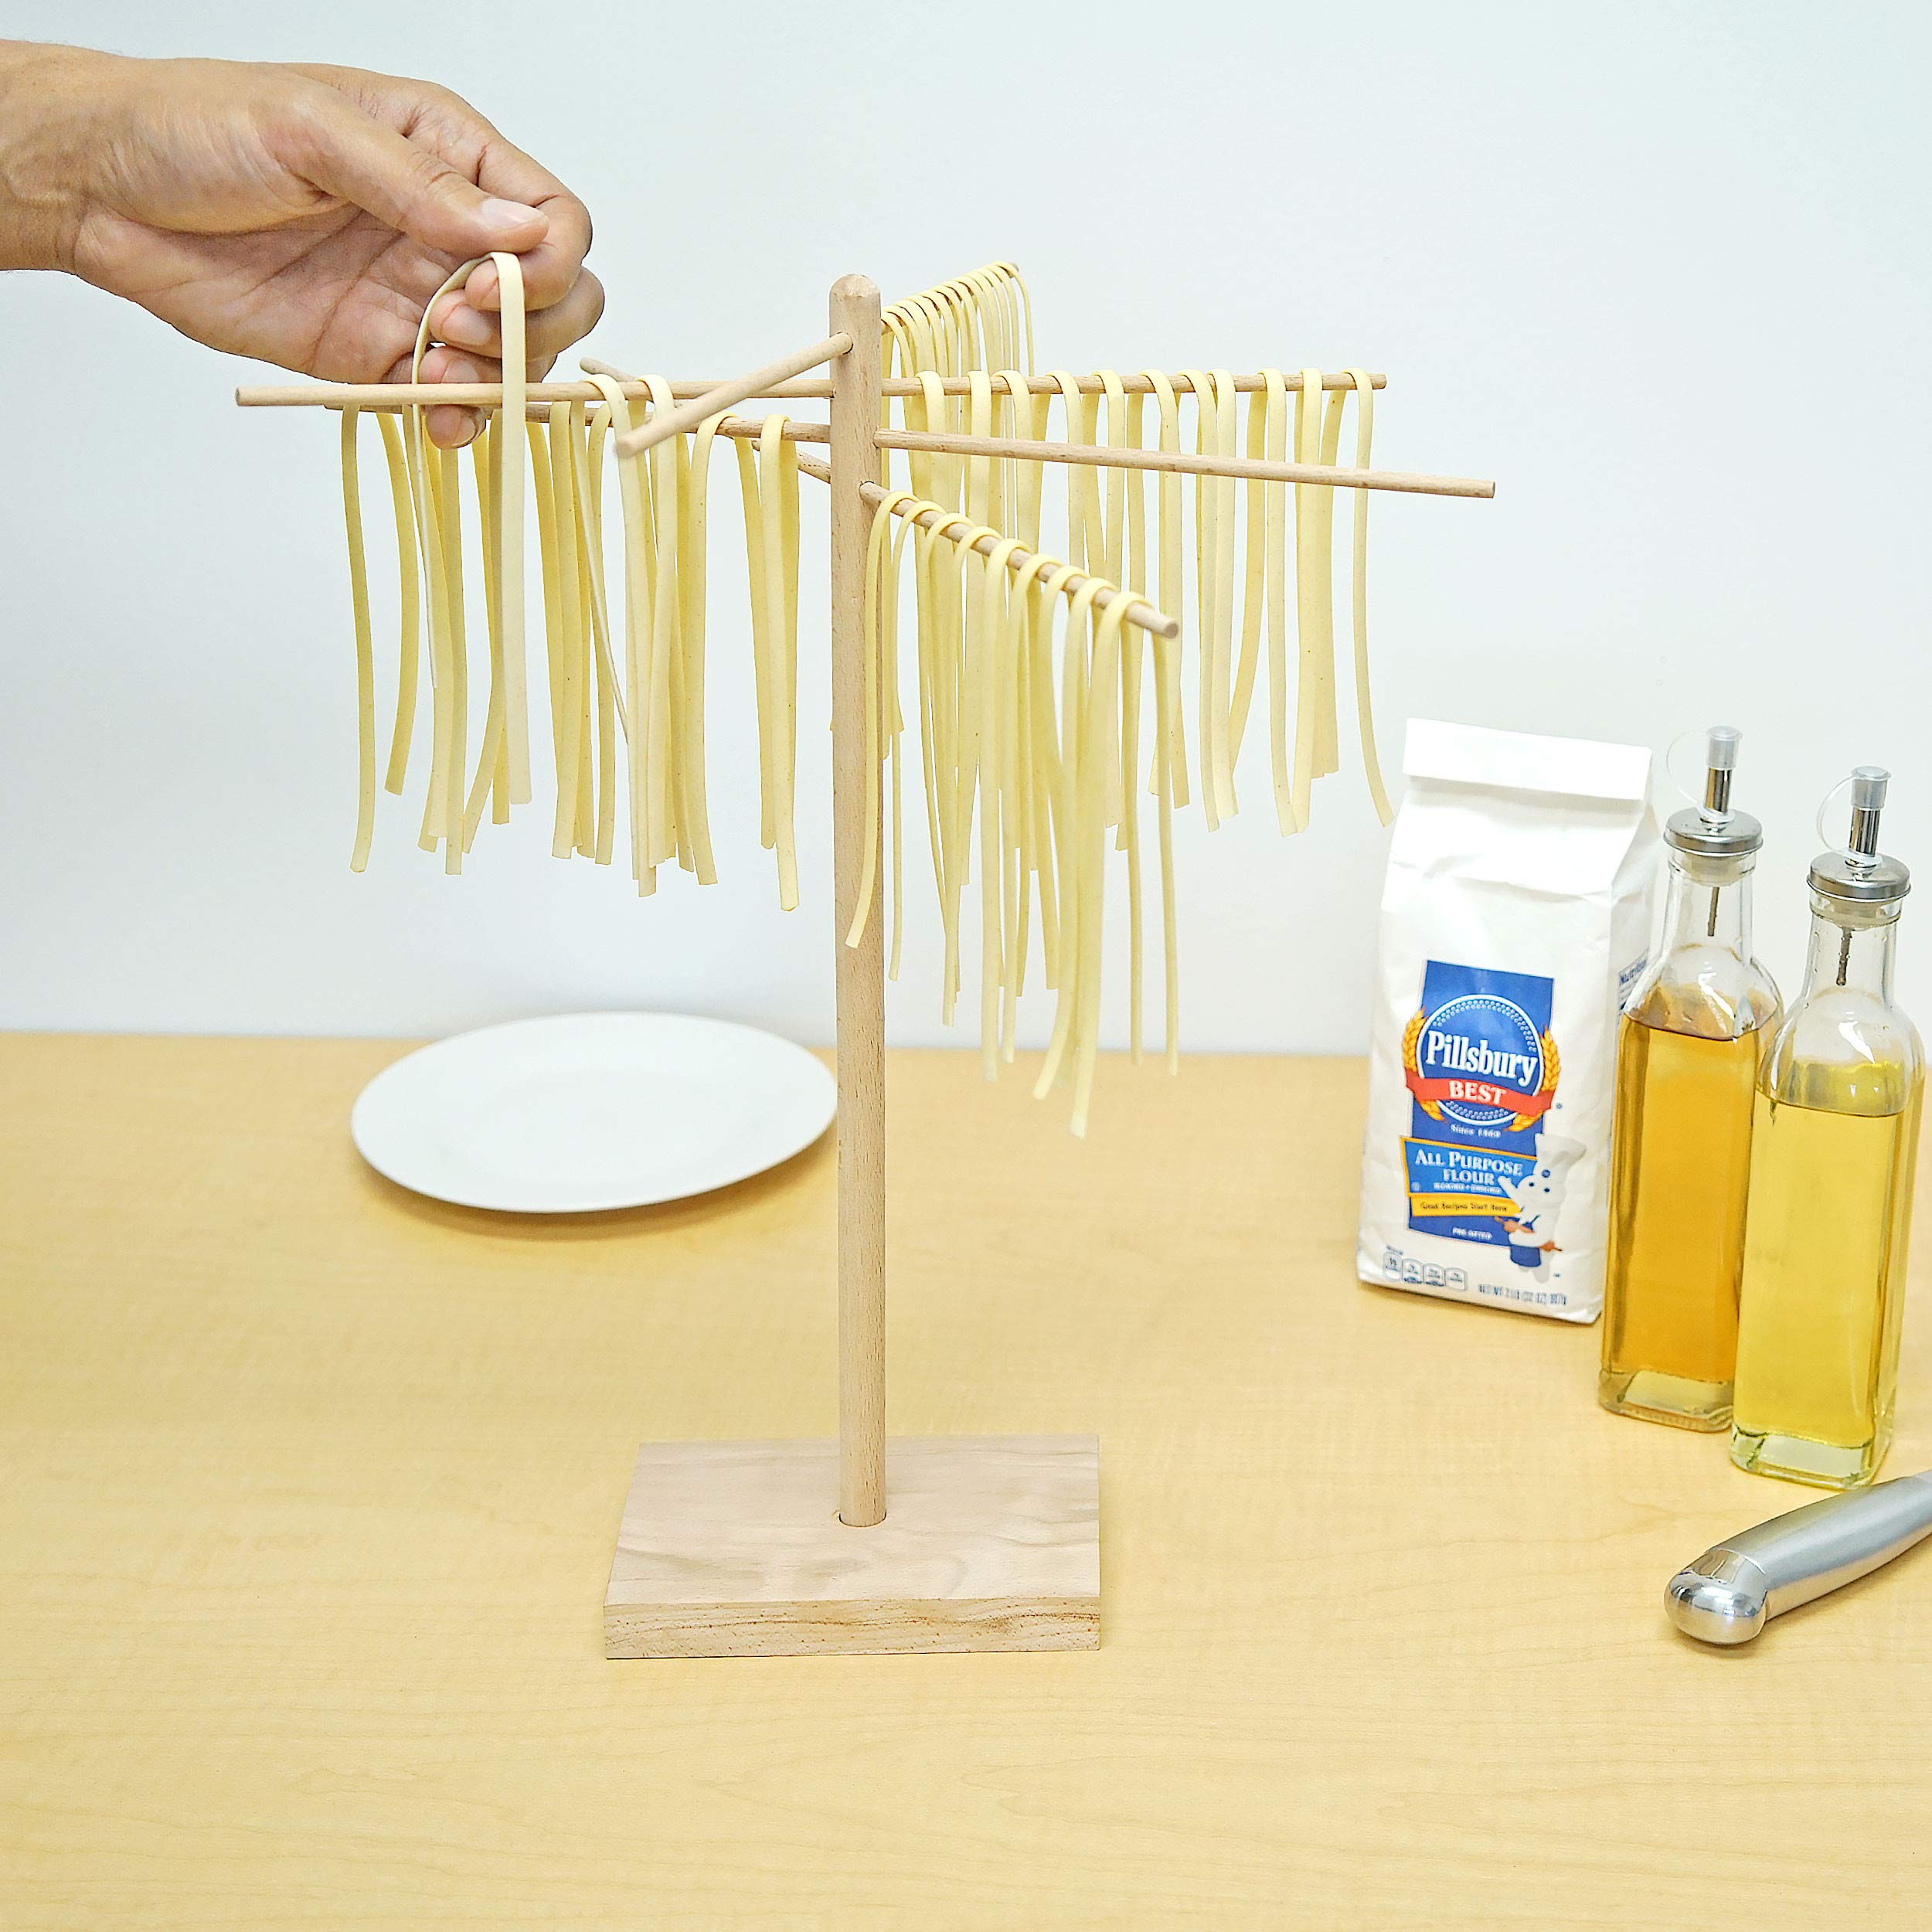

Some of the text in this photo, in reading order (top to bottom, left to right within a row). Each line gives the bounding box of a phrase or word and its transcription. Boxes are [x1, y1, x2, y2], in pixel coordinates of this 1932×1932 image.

[1426, 1030, 1538, 1087] Pillsbury
[1448, 1080, 1507, 1105] BEST
[1415, 1148, 1523, 1176] ALL PURPOSE
[1443, 1168, 1495, 1185] FLOUR
